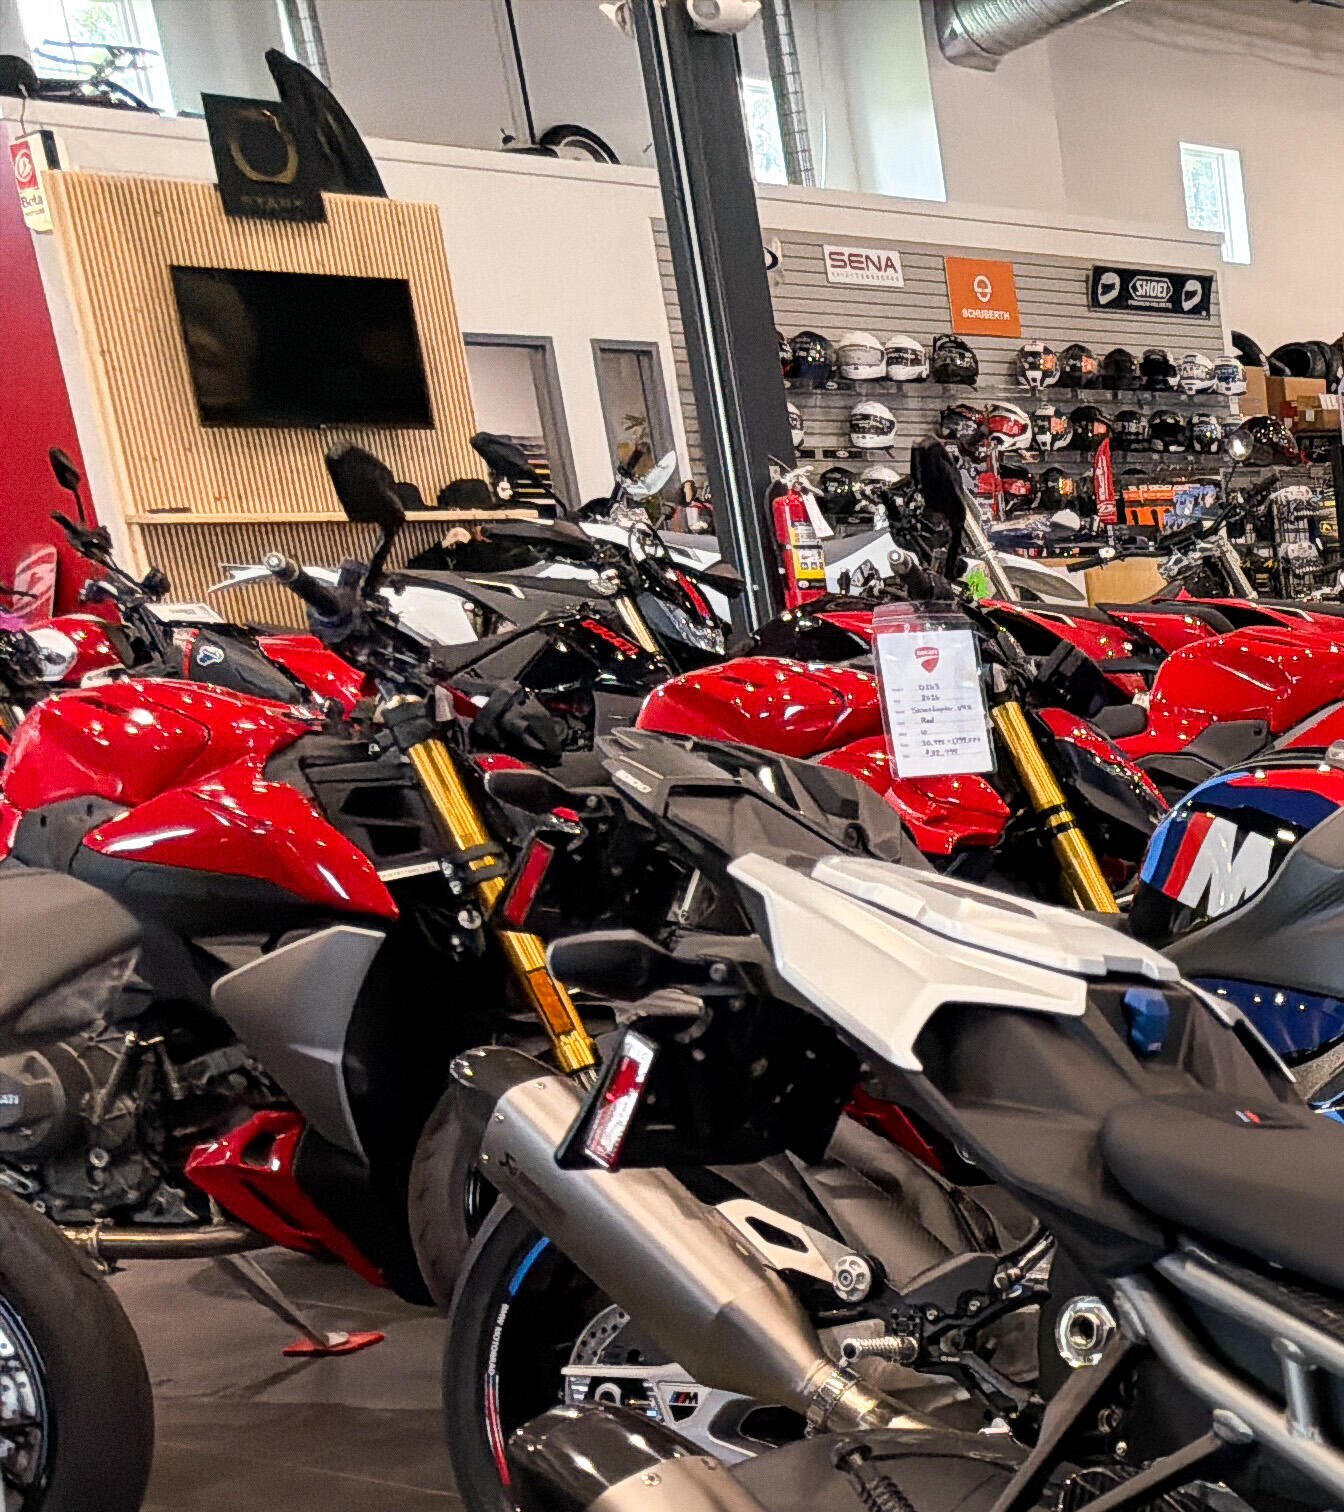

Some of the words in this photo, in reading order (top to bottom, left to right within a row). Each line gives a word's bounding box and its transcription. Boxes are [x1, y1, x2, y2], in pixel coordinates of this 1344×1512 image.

[829, 251, 898, 274] SENA
[1135, 280, 1168, 298] SHOEI
[962, 308, 1011, 321] SCHUBERTH
